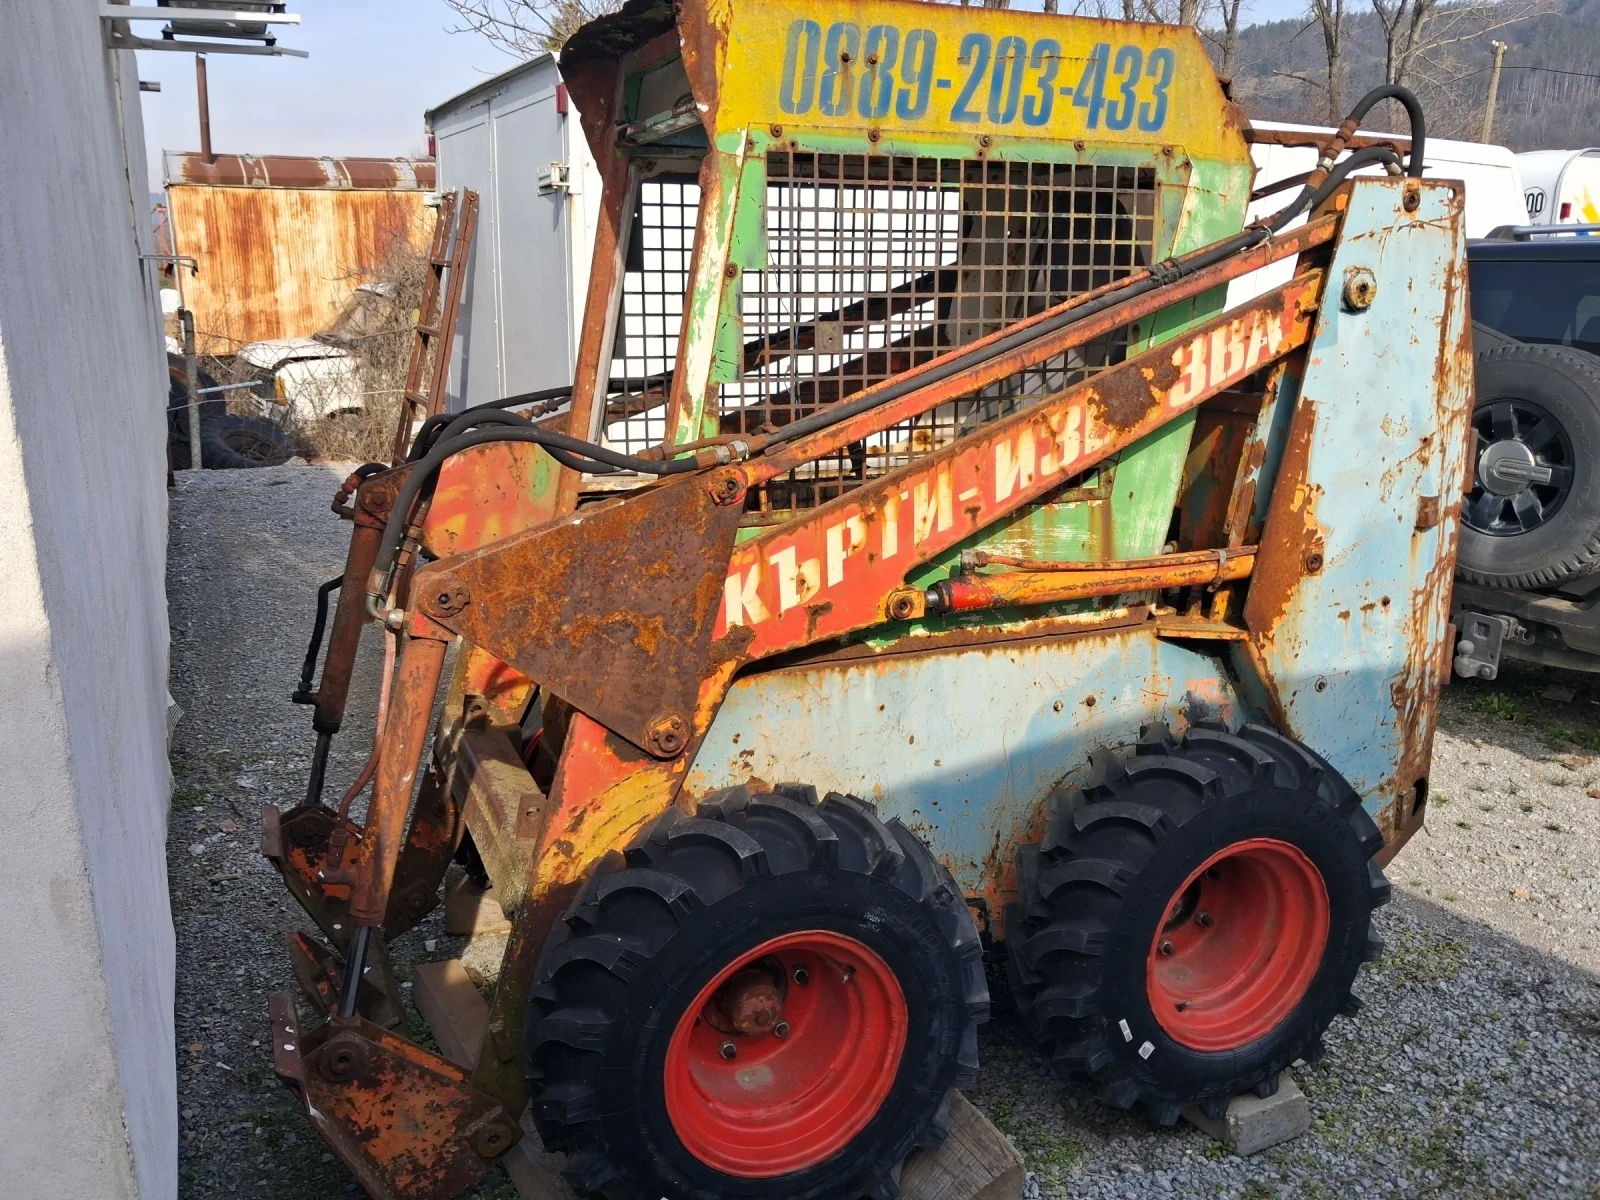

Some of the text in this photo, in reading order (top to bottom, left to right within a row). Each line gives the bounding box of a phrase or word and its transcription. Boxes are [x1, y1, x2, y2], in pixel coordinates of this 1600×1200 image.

[779, 18, 1175, 132] 0889-203-433
[1524, 191, 1545, 214] 00
[724, 309, 1284, 630] КЪРТИ-ИЗЗВА
